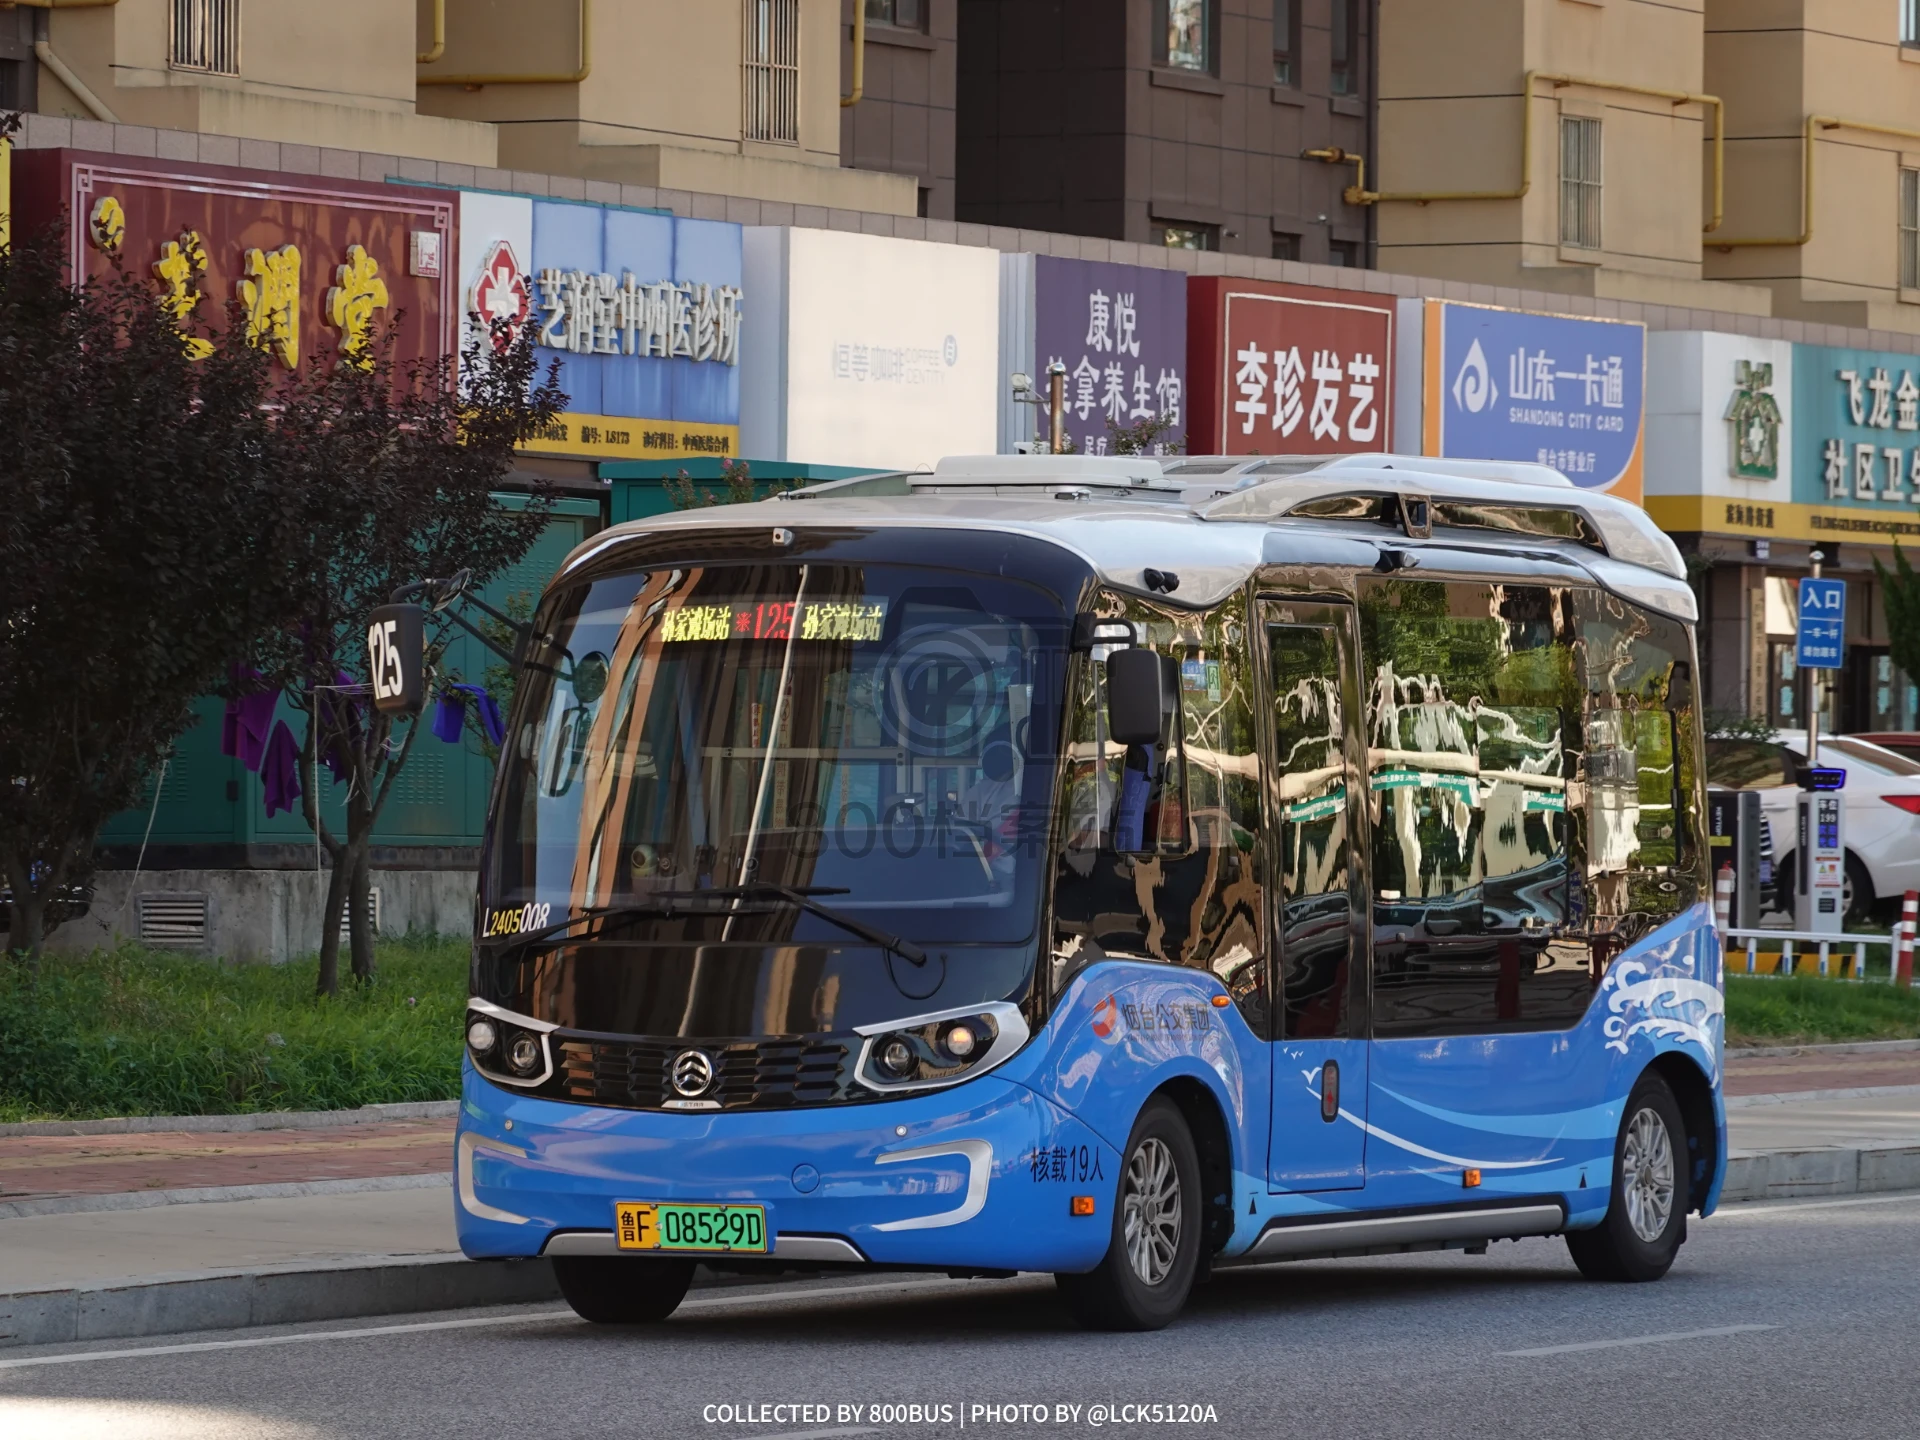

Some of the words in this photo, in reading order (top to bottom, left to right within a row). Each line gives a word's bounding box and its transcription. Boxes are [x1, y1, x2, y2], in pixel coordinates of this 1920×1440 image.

[1086, 289, 1140, 358] 康悦
[832, 340, 904, 384] 恒等咖啡
[905, 347, 940, 366] COFFEE
[1235, 341, 1380, 442] 李珍发艺
[1509, 347, 1624, 408] 山东一卡通
[1509, 407, 1564, 427] SHANDONG
[1568, 412, 1592, 429] CITY
[1596, 415, 1624, 432] CARD
[1803, 586, 1841, 609] 入口
[368, 620, 403, 700] 125
[482, 902, 551, 938] L2405008
[1120, 1003, 1210, 1030] 烟台公交集团
[1030, 1145, 1104, 1183] 核载19人
[665, 1211, 762, 1245] 08529D
